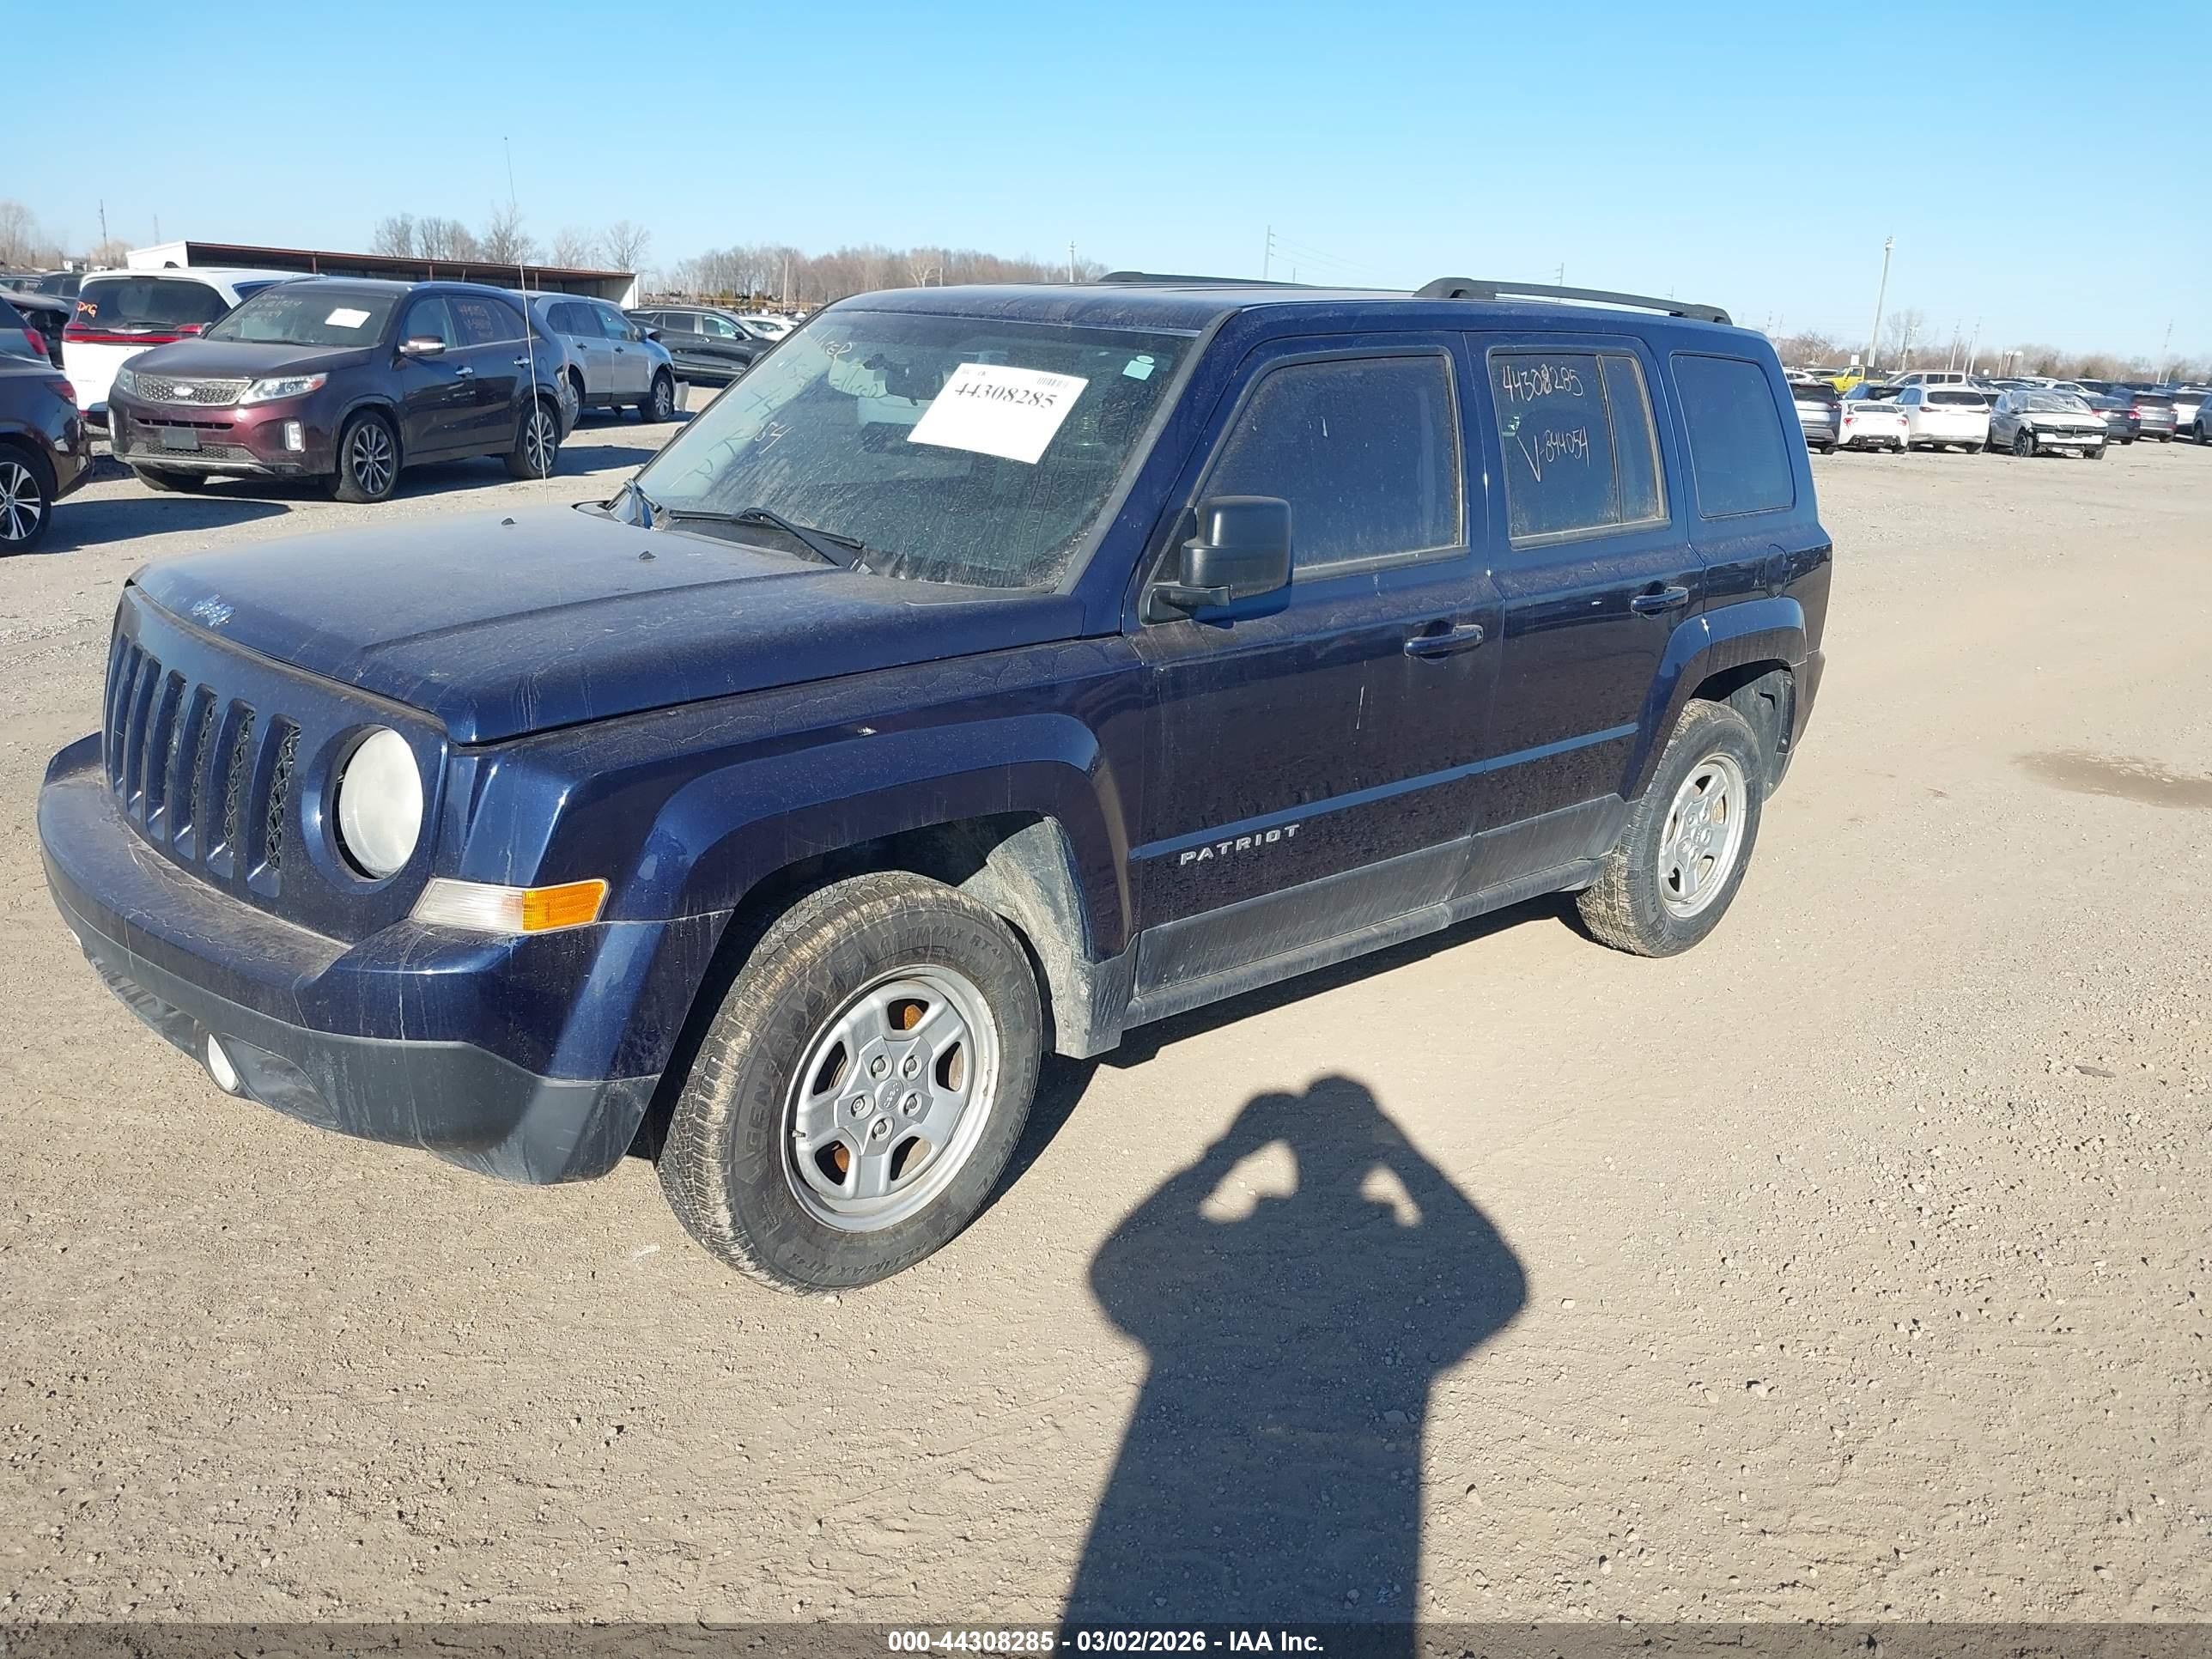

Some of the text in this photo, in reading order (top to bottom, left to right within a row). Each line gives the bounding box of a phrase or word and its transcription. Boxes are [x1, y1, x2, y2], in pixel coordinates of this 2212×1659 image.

[954, 383, 1058, 409] 44308285
[1502, 364, 1583, 402] 44308285
[1180, 823, 1300, 866] PATRIOT
